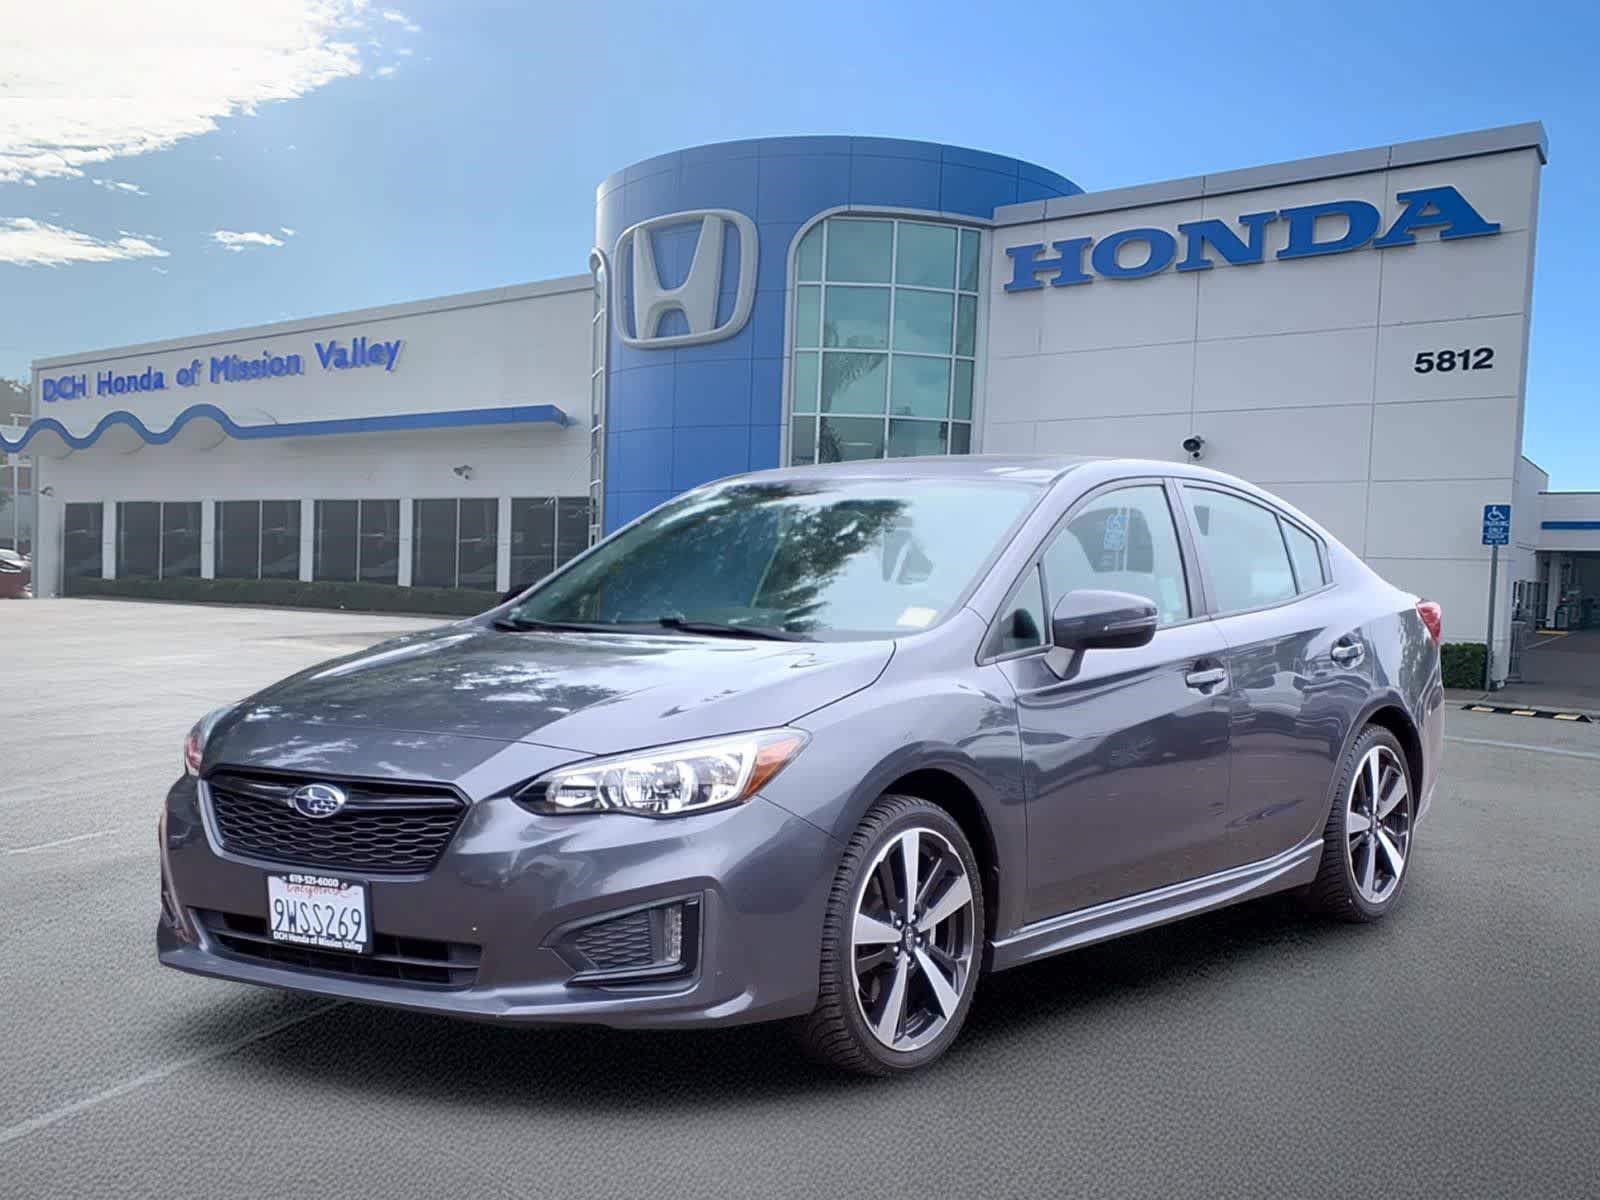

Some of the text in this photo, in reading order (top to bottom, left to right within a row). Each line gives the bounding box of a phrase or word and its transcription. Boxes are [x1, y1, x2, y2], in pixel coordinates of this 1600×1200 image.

[1004, 185, 1501, 293] HONDA
[42, 337, 403, 402] DCH Honda of Mission Valley
[1413, 347, 1495, 375] 5812
[274, 898, 362, 941] 9WSS269
